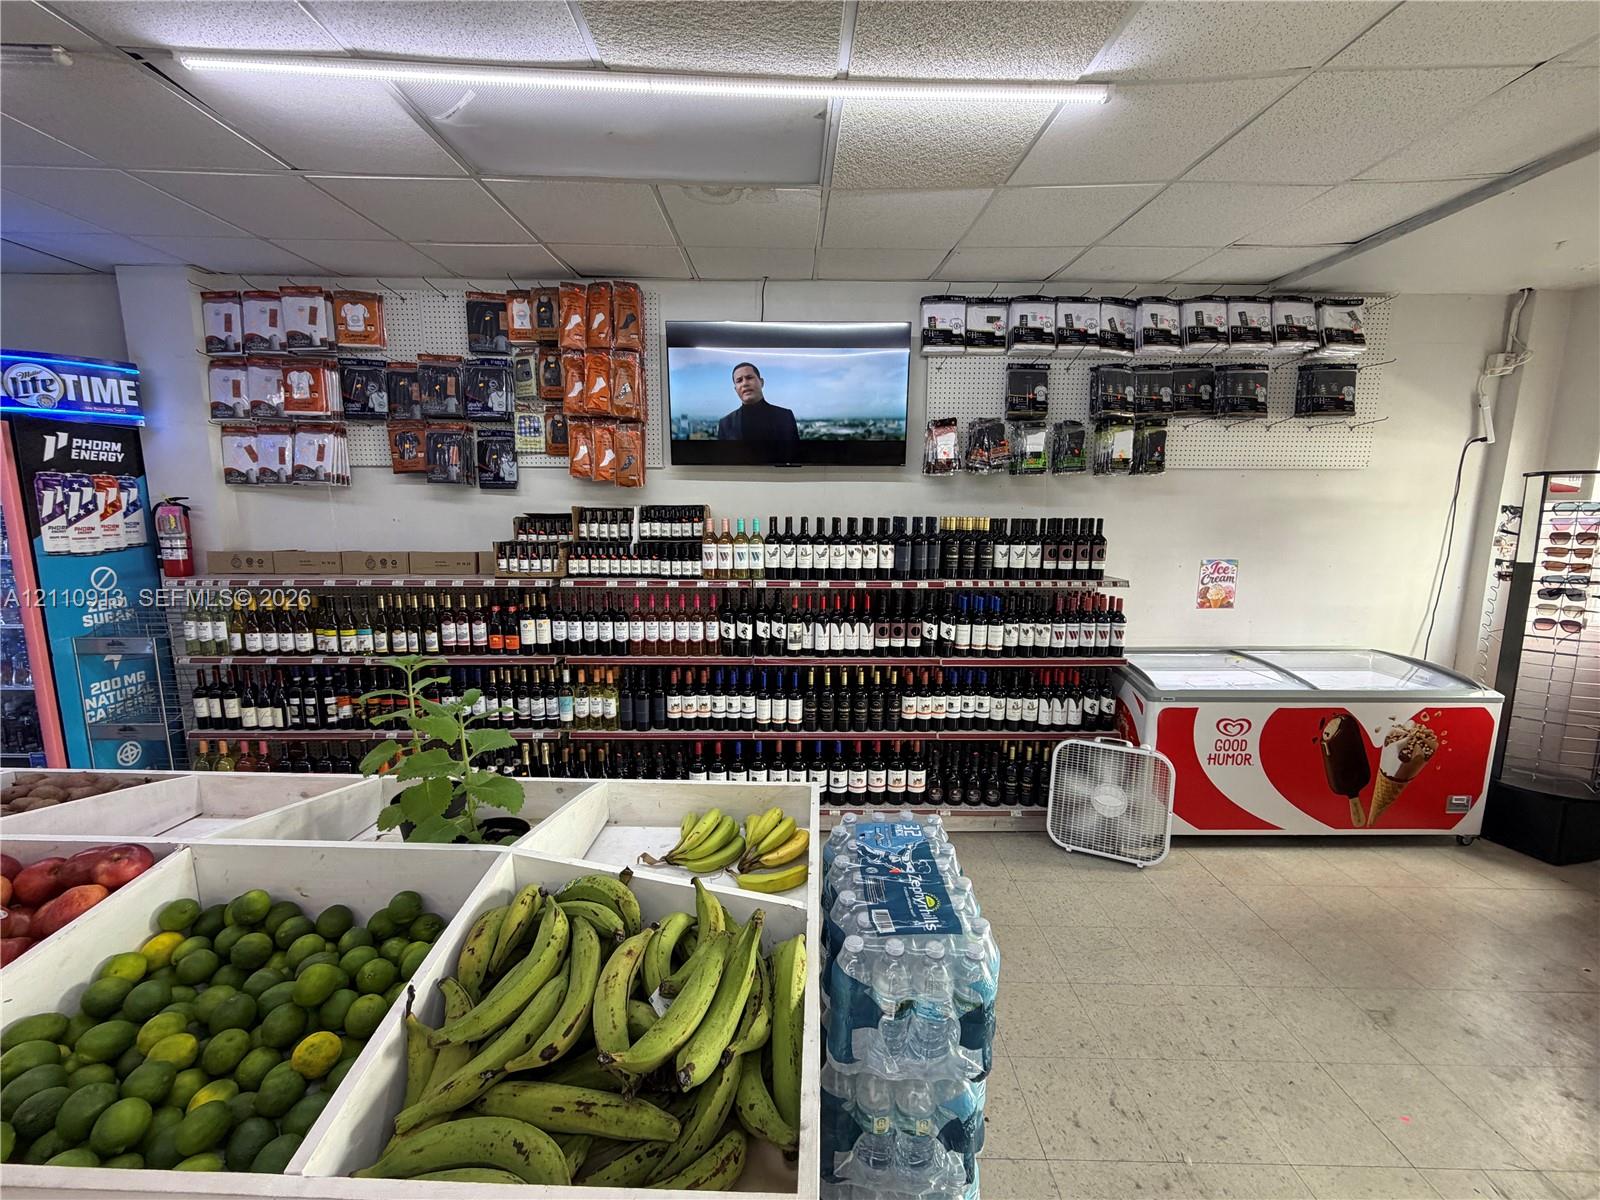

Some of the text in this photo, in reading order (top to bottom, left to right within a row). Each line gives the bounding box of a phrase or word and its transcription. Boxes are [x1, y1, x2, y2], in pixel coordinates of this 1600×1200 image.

[59, 373, 139, 406] TIME
[72, 438, 122, 452] PHORM
[70, 449, 125, 462] ENERGY
[1210, 561, 1230, 575] Ice
[1200, 574, 1236, 586] Cream
[90, 671, 146, 695] 200 MG
[85, 682, 155, 710] NATURAL
[1215, 739, 1248, 752] GOOD
[1206, 753, 1253, 766] HUMOR
[903, 824, 922, 837] 32
[906, 874, 938, 931] Zephyrhills
